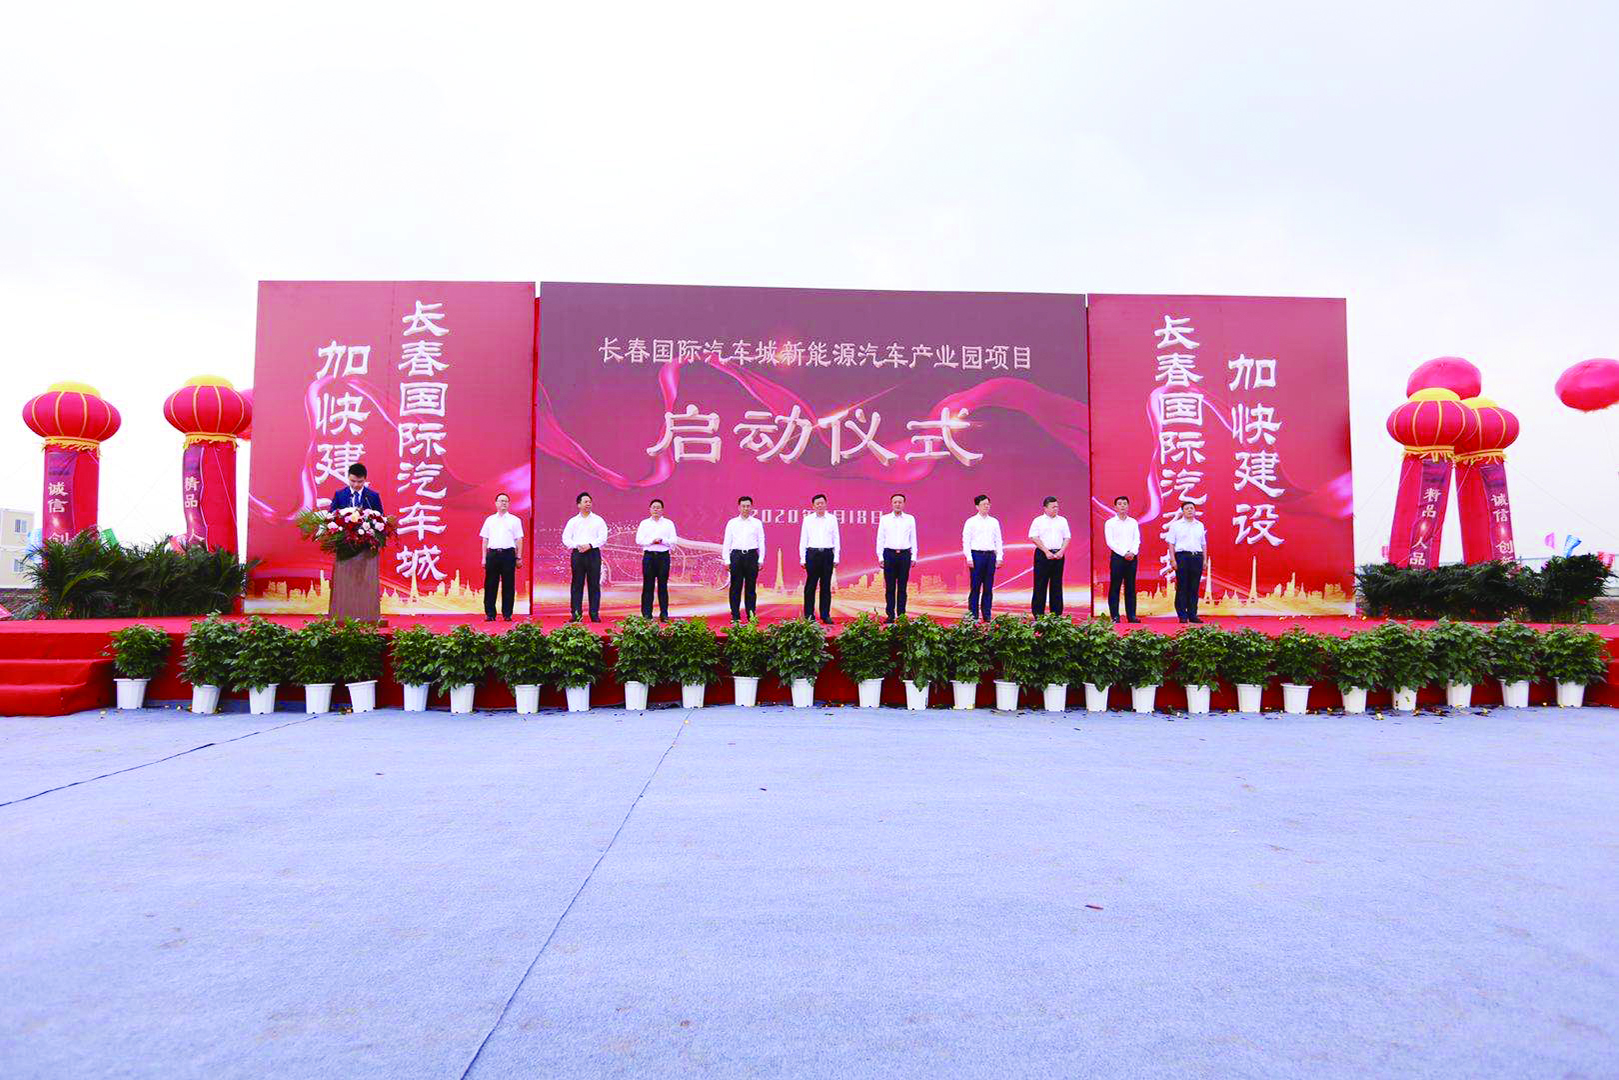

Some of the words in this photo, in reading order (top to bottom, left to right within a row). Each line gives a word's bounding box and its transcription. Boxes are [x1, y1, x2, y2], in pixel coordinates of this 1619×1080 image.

[315, 340, 370, 508] 加快建
[397, 300, 449, 580] 长春国际汽车城
[599, 337, 1031, 370] 长春国际汽车城新能源汽车产业园项目
[647, 403, 983, 466] 启动仪式
[1154, 315, 1207, 583] 长春国际汽
[1228, 353, 1285, 547] 加快建设
